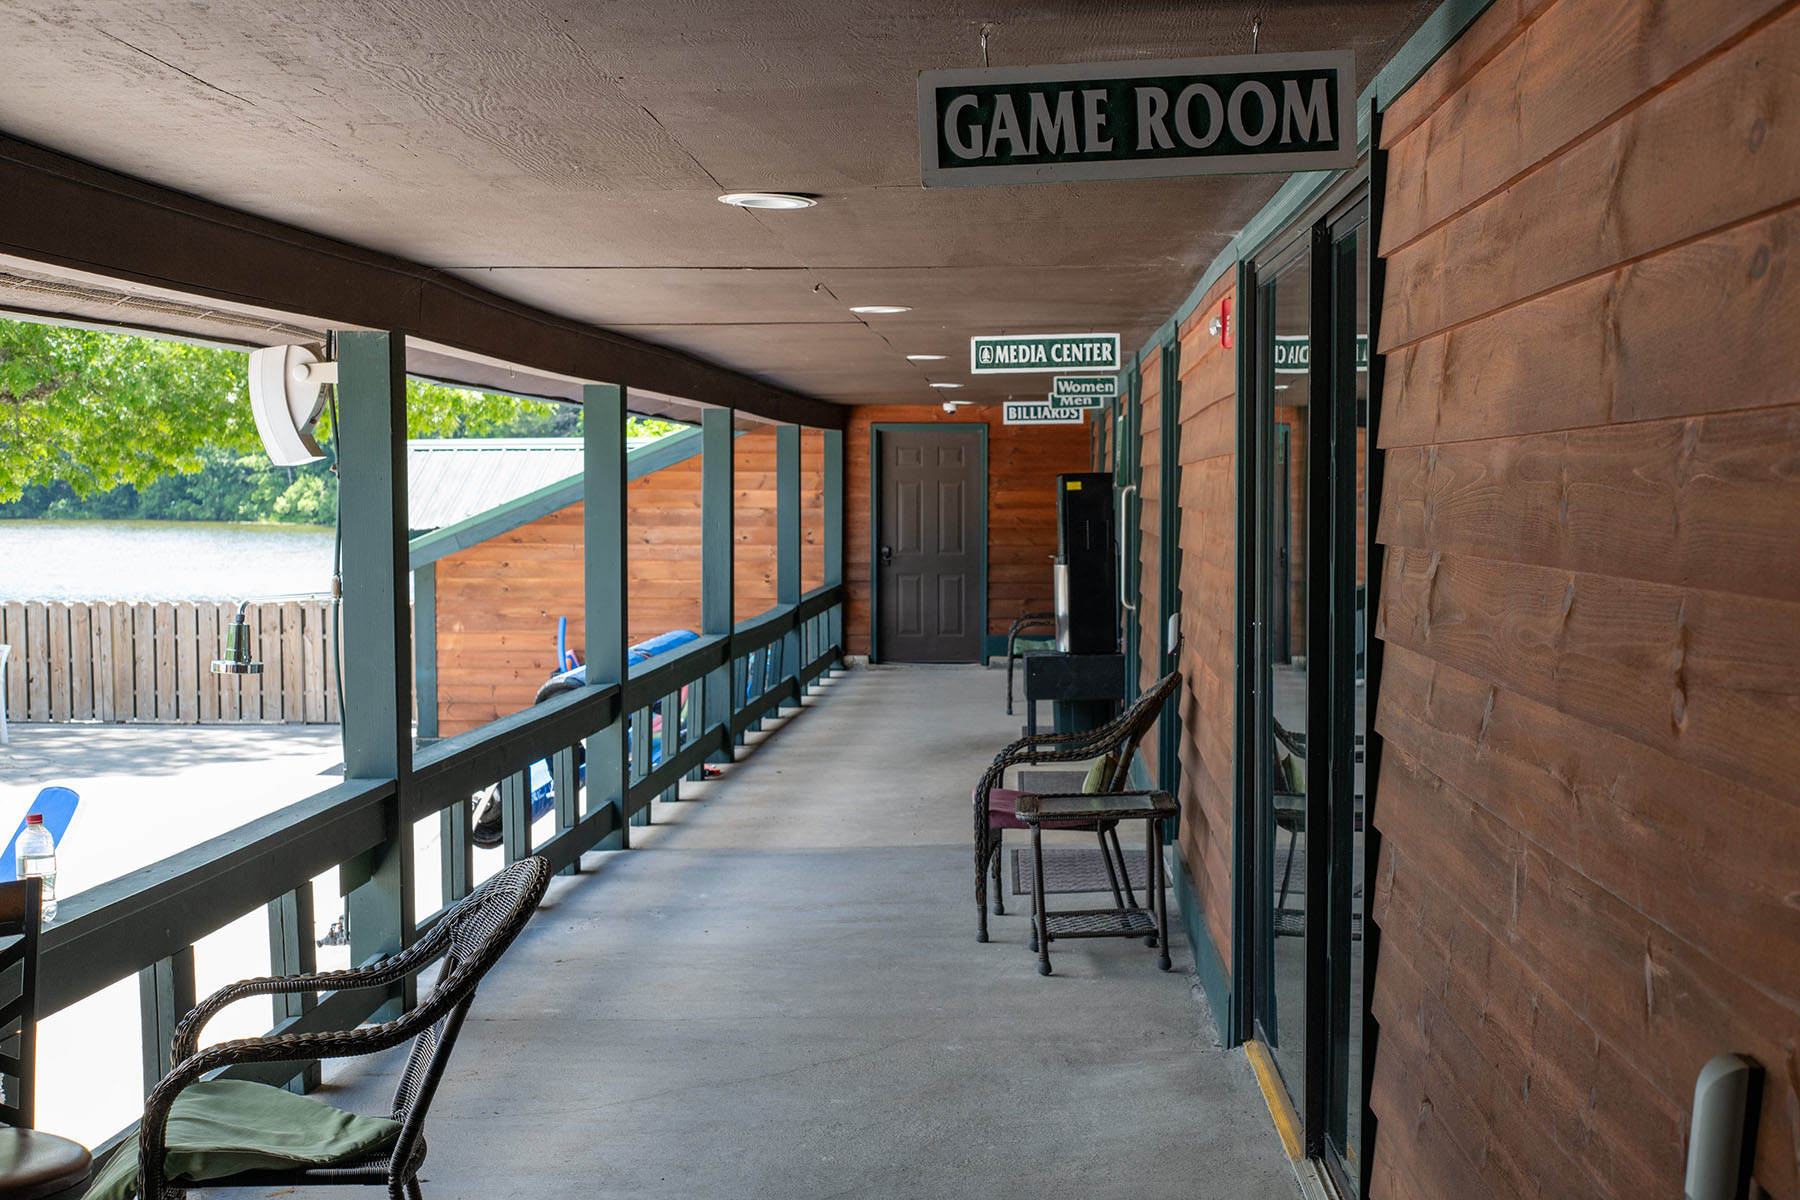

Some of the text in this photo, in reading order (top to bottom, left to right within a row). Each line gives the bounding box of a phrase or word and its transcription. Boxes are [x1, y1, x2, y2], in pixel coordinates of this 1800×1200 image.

[943, 78, 1334, 160] GAME ROOM
[995, 343, 1113, 364] MEDIA CENTER
[1057, 380, 1114, 393] Women
[1060, 396, 1092, 406] Men
[1008, 406, 1079, 420] BILLIARDS
